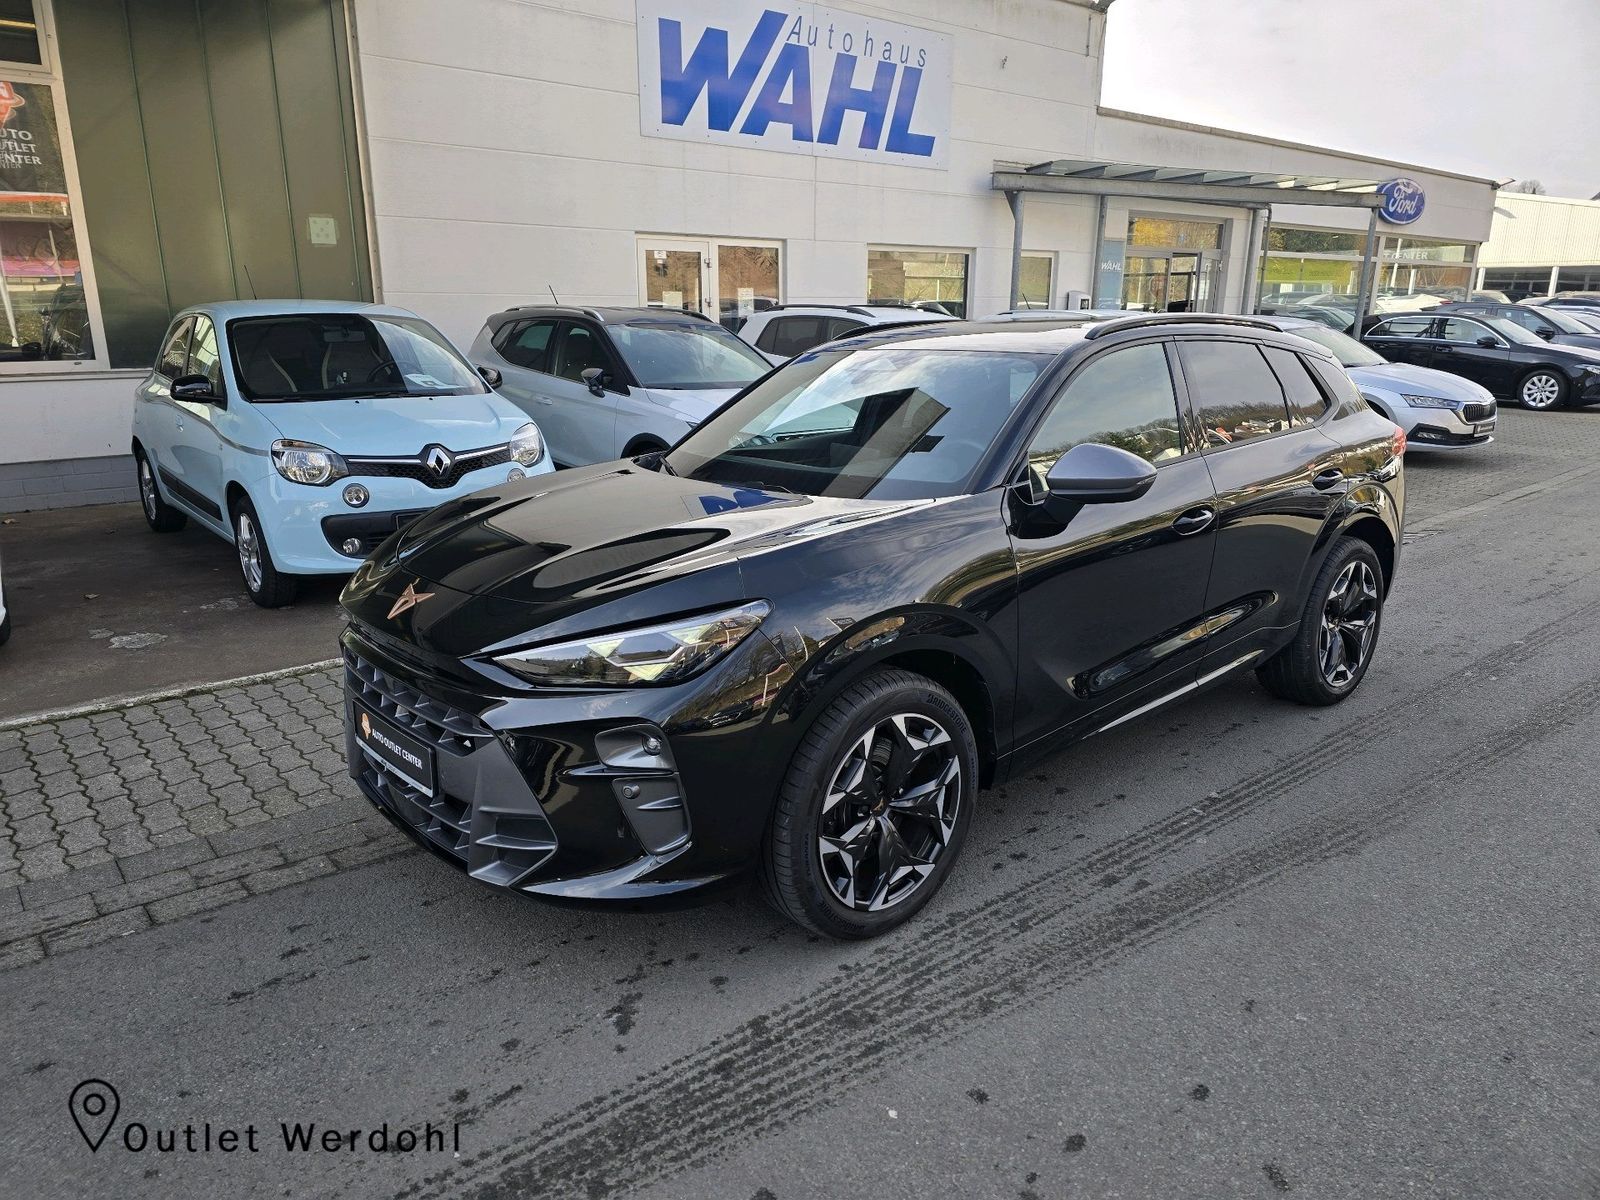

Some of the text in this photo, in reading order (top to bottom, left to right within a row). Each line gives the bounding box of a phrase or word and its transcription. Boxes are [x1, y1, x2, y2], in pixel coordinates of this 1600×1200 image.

[786, 15, 927, 67] Autohaus
[658, 9, 936, 157] WAHL
[1388, 184, 1419, 215] Ford
[1101, 260, 1122, 271] WAHL
[927, 693, 967, 734] BRIDGESTONE
[371, 728, 423, 770] AUTO OUTLET CENTER
